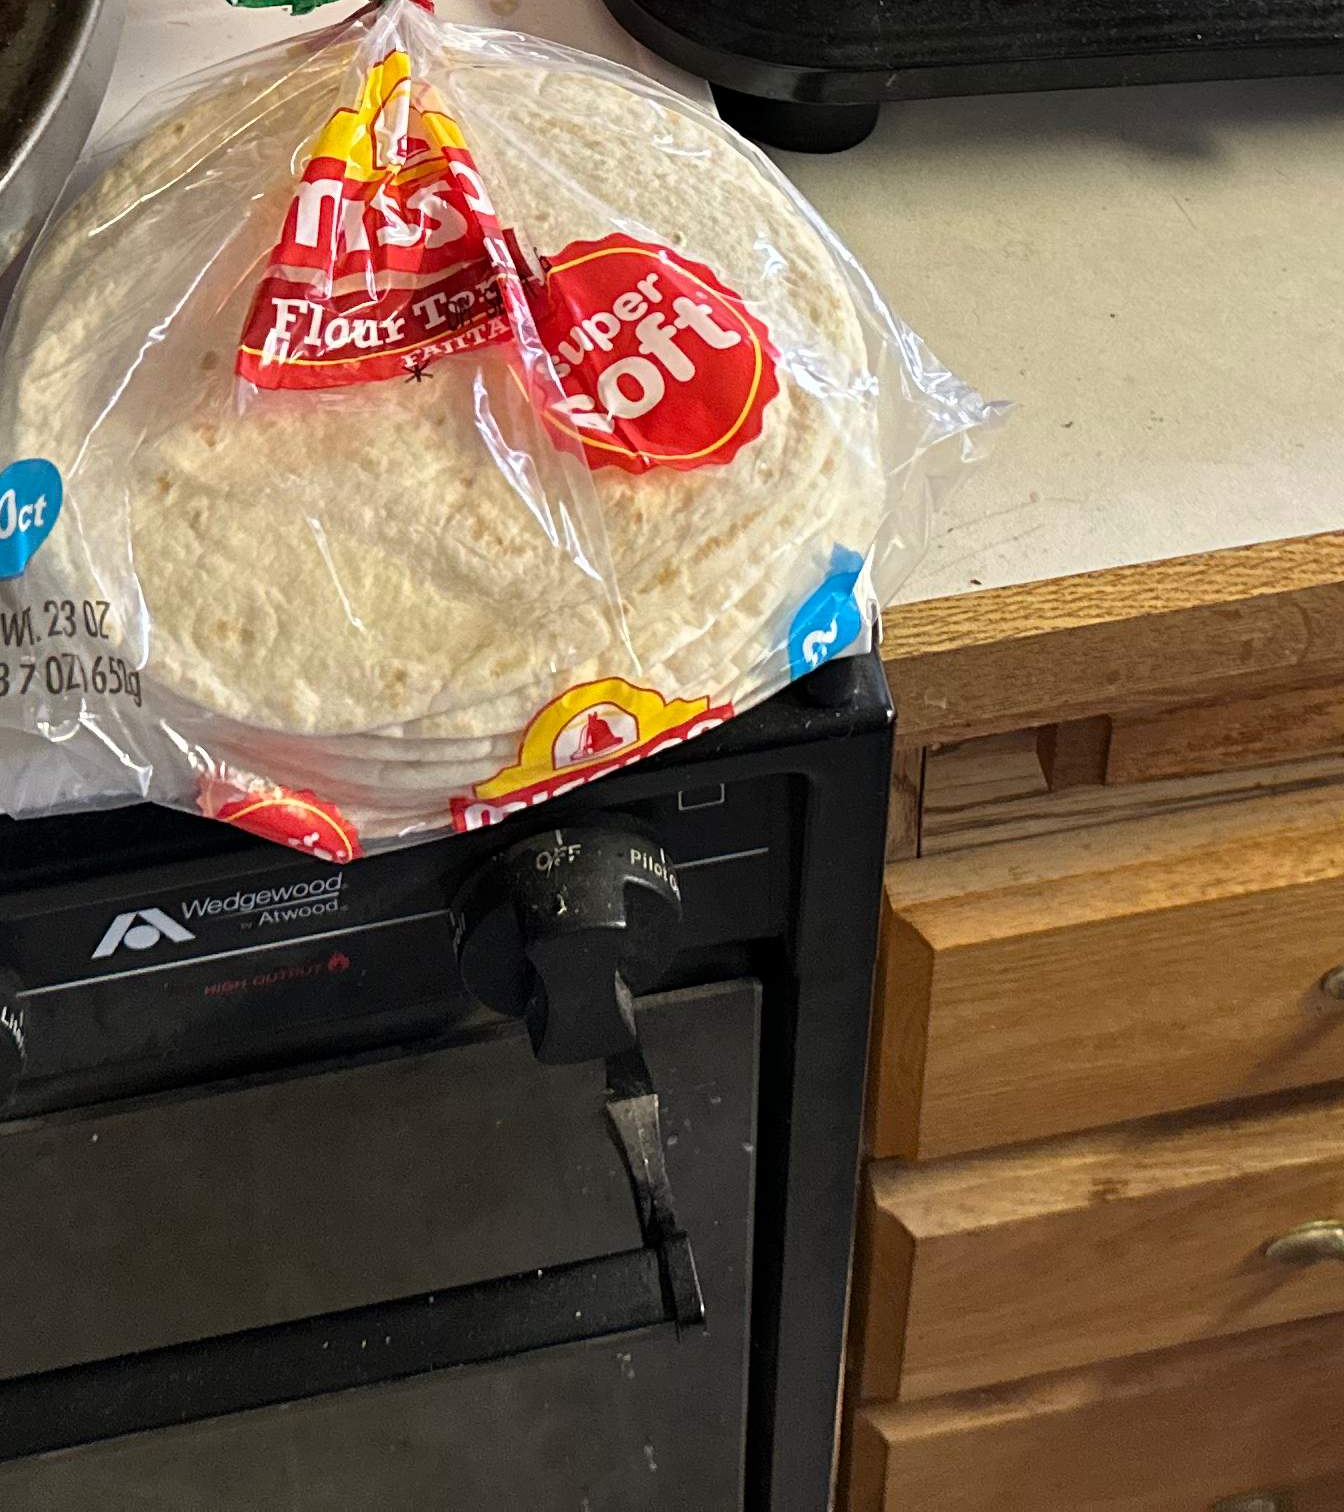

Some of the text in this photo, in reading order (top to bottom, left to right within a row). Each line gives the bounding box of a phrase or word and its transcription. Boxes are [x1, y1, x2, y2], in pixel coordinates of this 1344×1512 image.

[272, 296, 407, 350] Flour
[44, 600, 77, 638] 23
[83, 600, 111, 639] OZ
[20, 663, 36, 695] 7
[536, 843, 582, 878] OFF
[182, 871, 343, 921] Wedgewood
[258, 899, 340, 927] Atwood
[204, 964, 323, 996] HIGH OUTPUT
